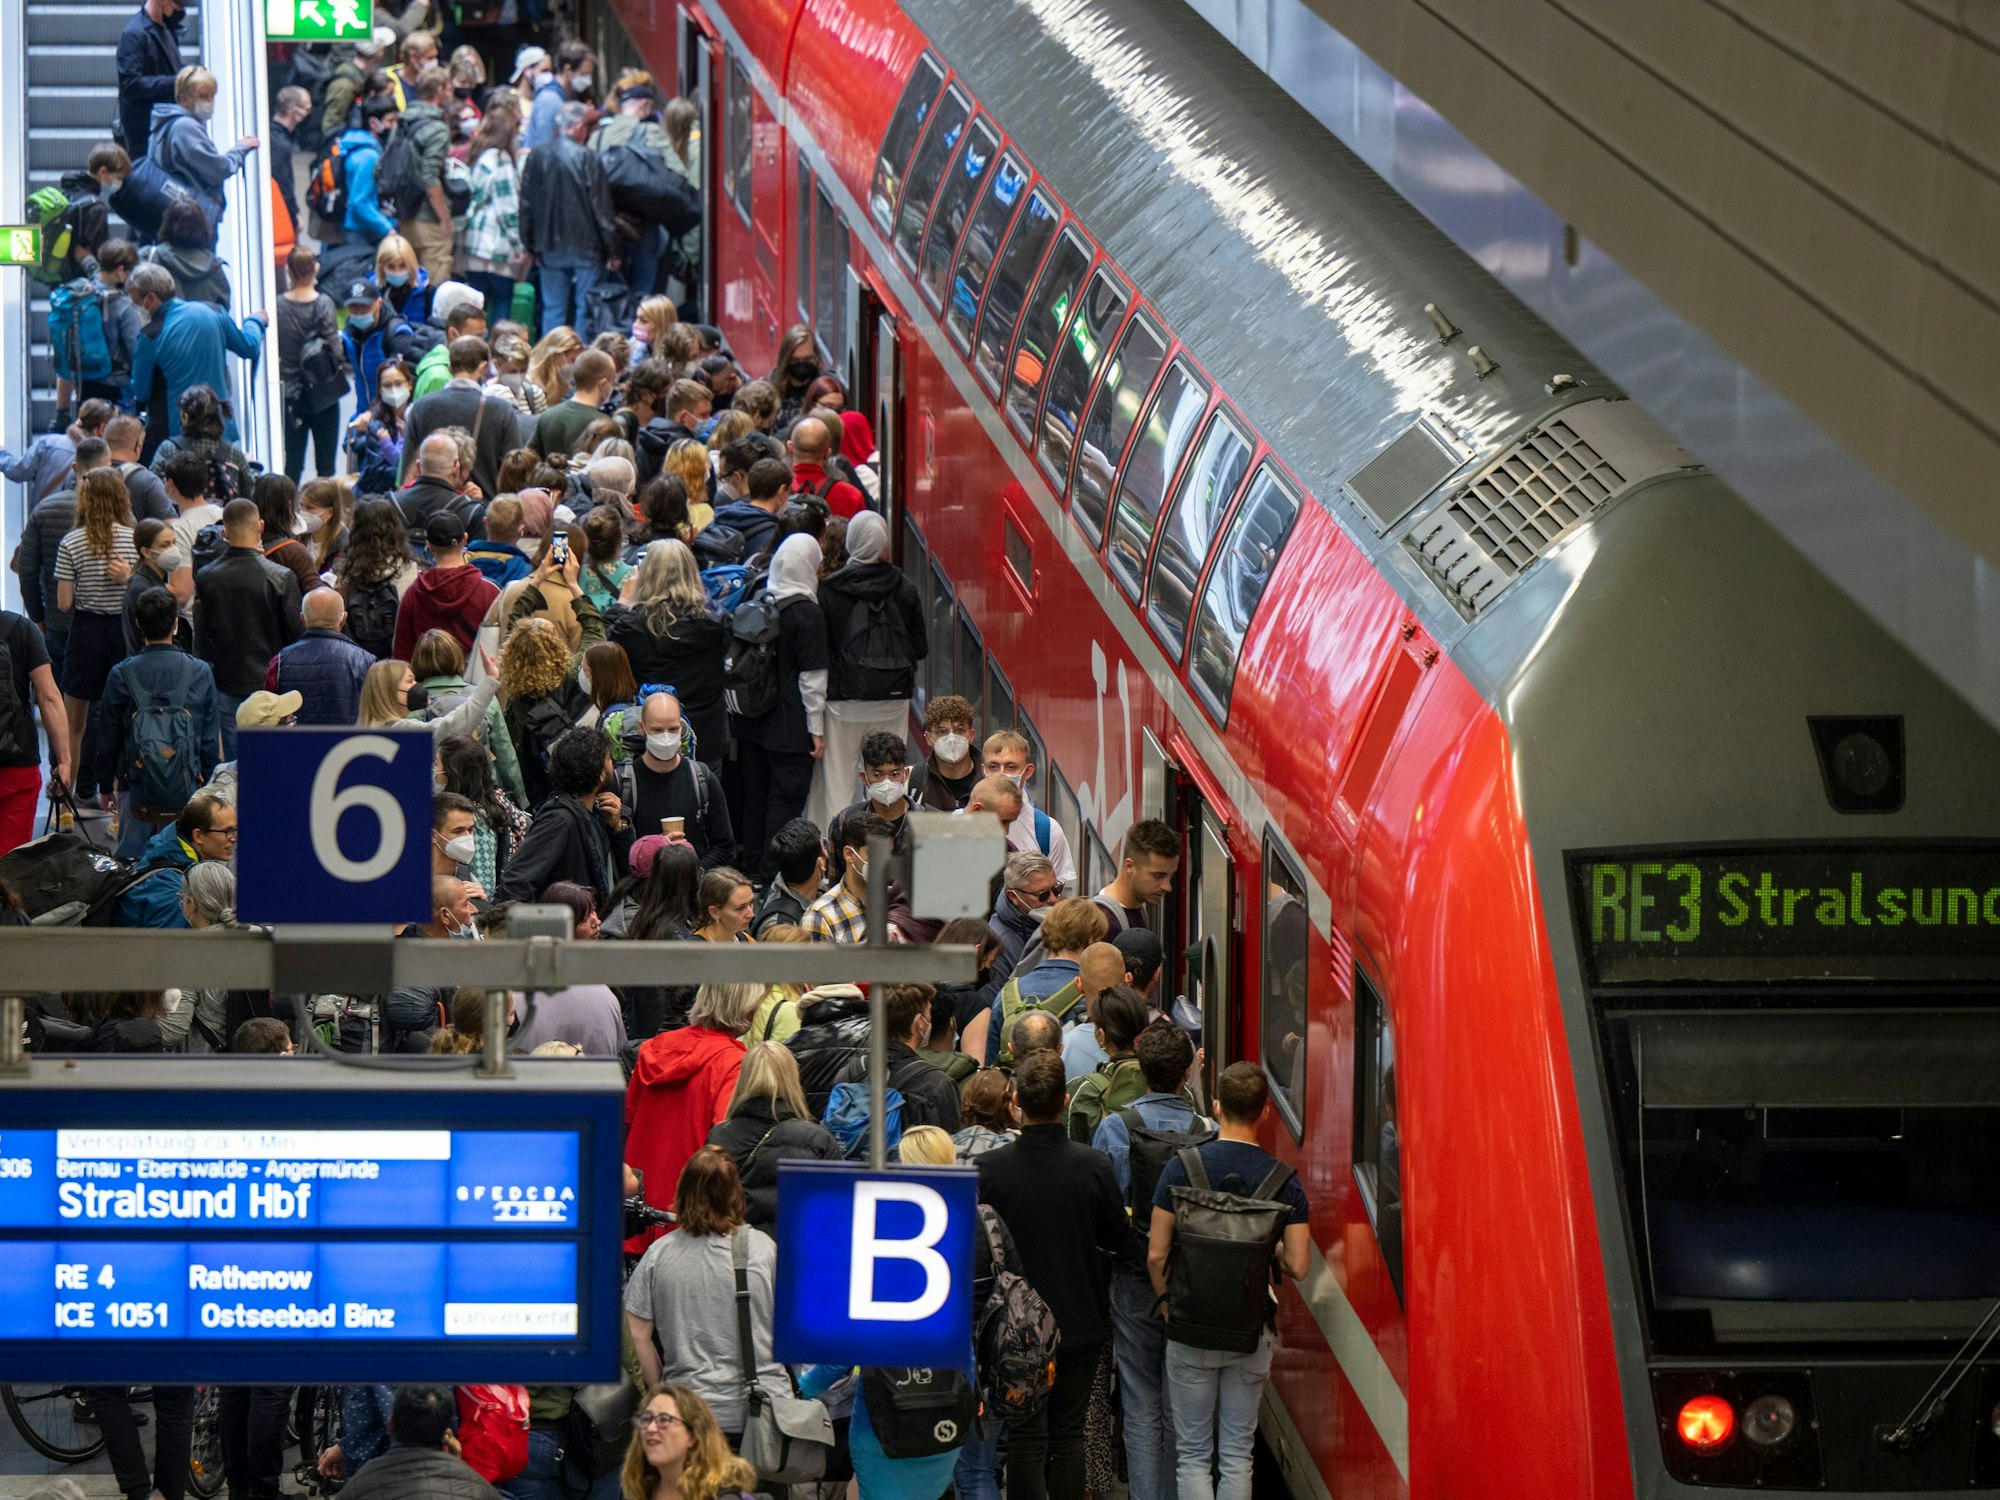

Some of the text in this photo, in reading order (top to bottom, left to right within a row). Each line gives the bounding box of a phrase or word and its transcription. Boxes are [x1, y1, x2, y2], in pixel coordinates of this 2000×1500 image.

[311, 735, 405, 882] 6
[1592, 863, 1701, 942] RE3
[56, 1159, 121, 1178] Bernau
[137, 1159, 249, 1179] Eberswalde
[58, 1182, 312, 1219] Stralsund Hbf
[848, 1180, 951, 1322] B
[55, 1263, 313, 1290] RE 4 Rathenow
[55, 1302, 95, 1328] ICE
[105, 1302, 168, 1328] 1051
[201, 1302, 337, 1328] Ostseebad
[344, 1303, 395, 1328] Binz
